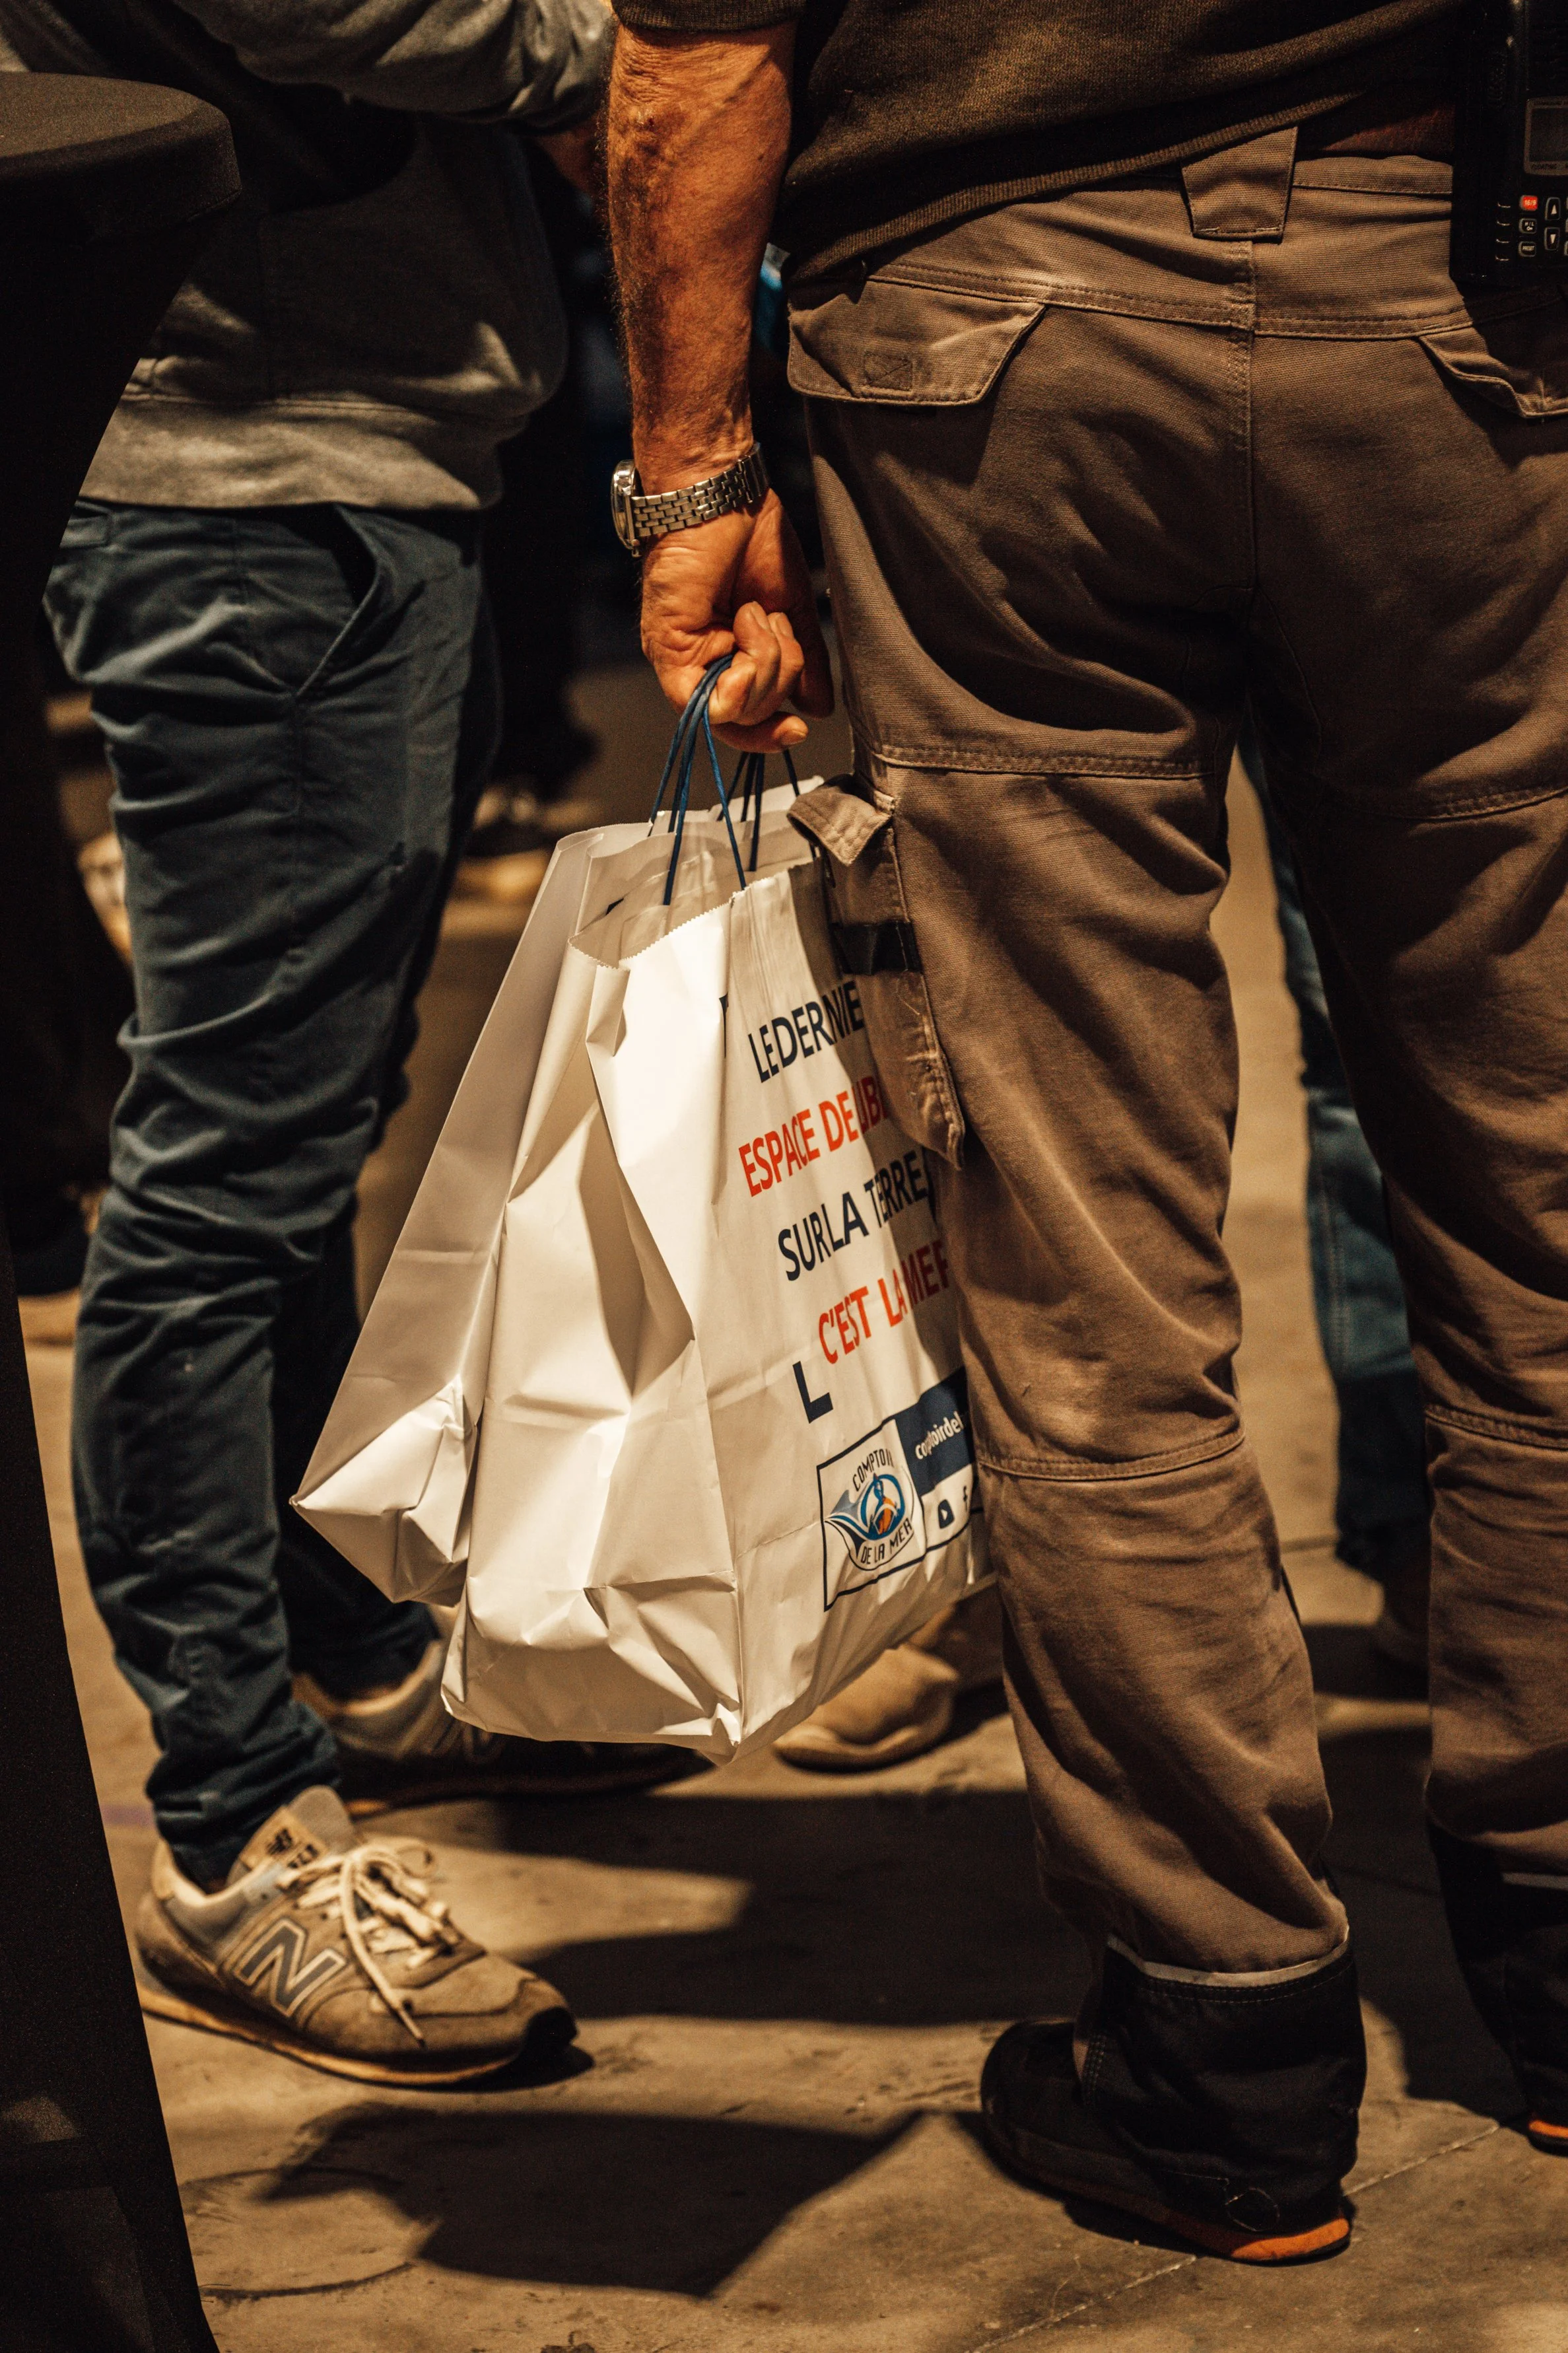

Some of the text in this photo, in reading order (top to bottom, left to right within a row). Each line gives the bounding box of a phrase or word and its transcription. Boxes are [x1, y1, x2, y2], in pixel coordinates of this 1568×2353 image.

[738, 1109, 821, 1197] ESPACE
[819, 1090, 860, 1152] DE
[819, 1286, 871, 1364] C'EST
[877, 1269, 908, 1327] LA
[860, 1518, 913, 1564] DE LA MER
[234, 1918, 346, 2017] N
